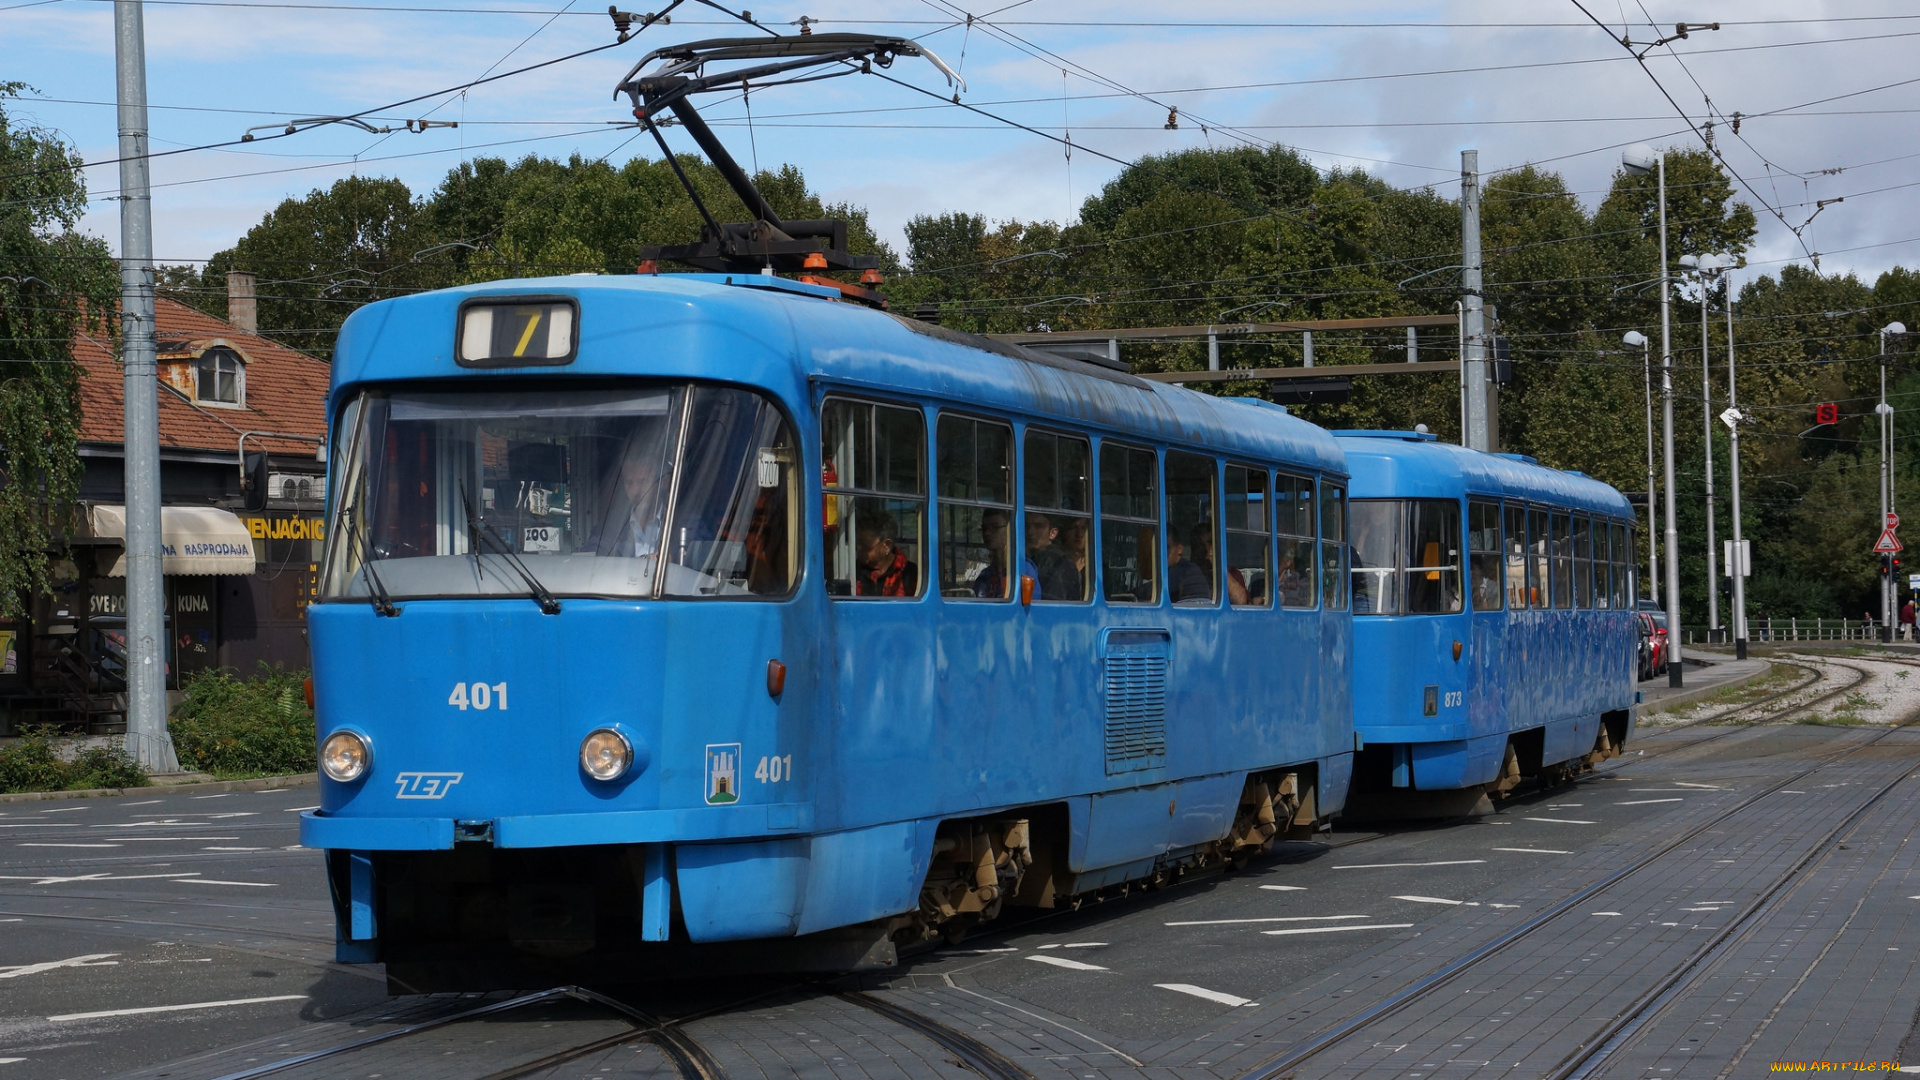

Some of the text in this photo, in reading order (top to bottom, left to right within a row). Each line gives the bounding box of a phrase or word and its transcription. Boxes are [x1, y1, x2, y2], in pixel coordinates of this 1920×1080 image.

[514, 307, 544, 358] 7
[1820, 406, 1834, 422] S
[239, 514, 325, 540] JENJAČNIC
[184, 543, 249, 556] RASPRODAJA
[90, 594, 110, 613] SVE
[178, 594, 209, 613] KUNA
[448, 681, 509, 711] 401
[1444, 690, 1462, 708] 873
[754, 753, 792, 785] 401
[394, 771, 463, 800] ZET
